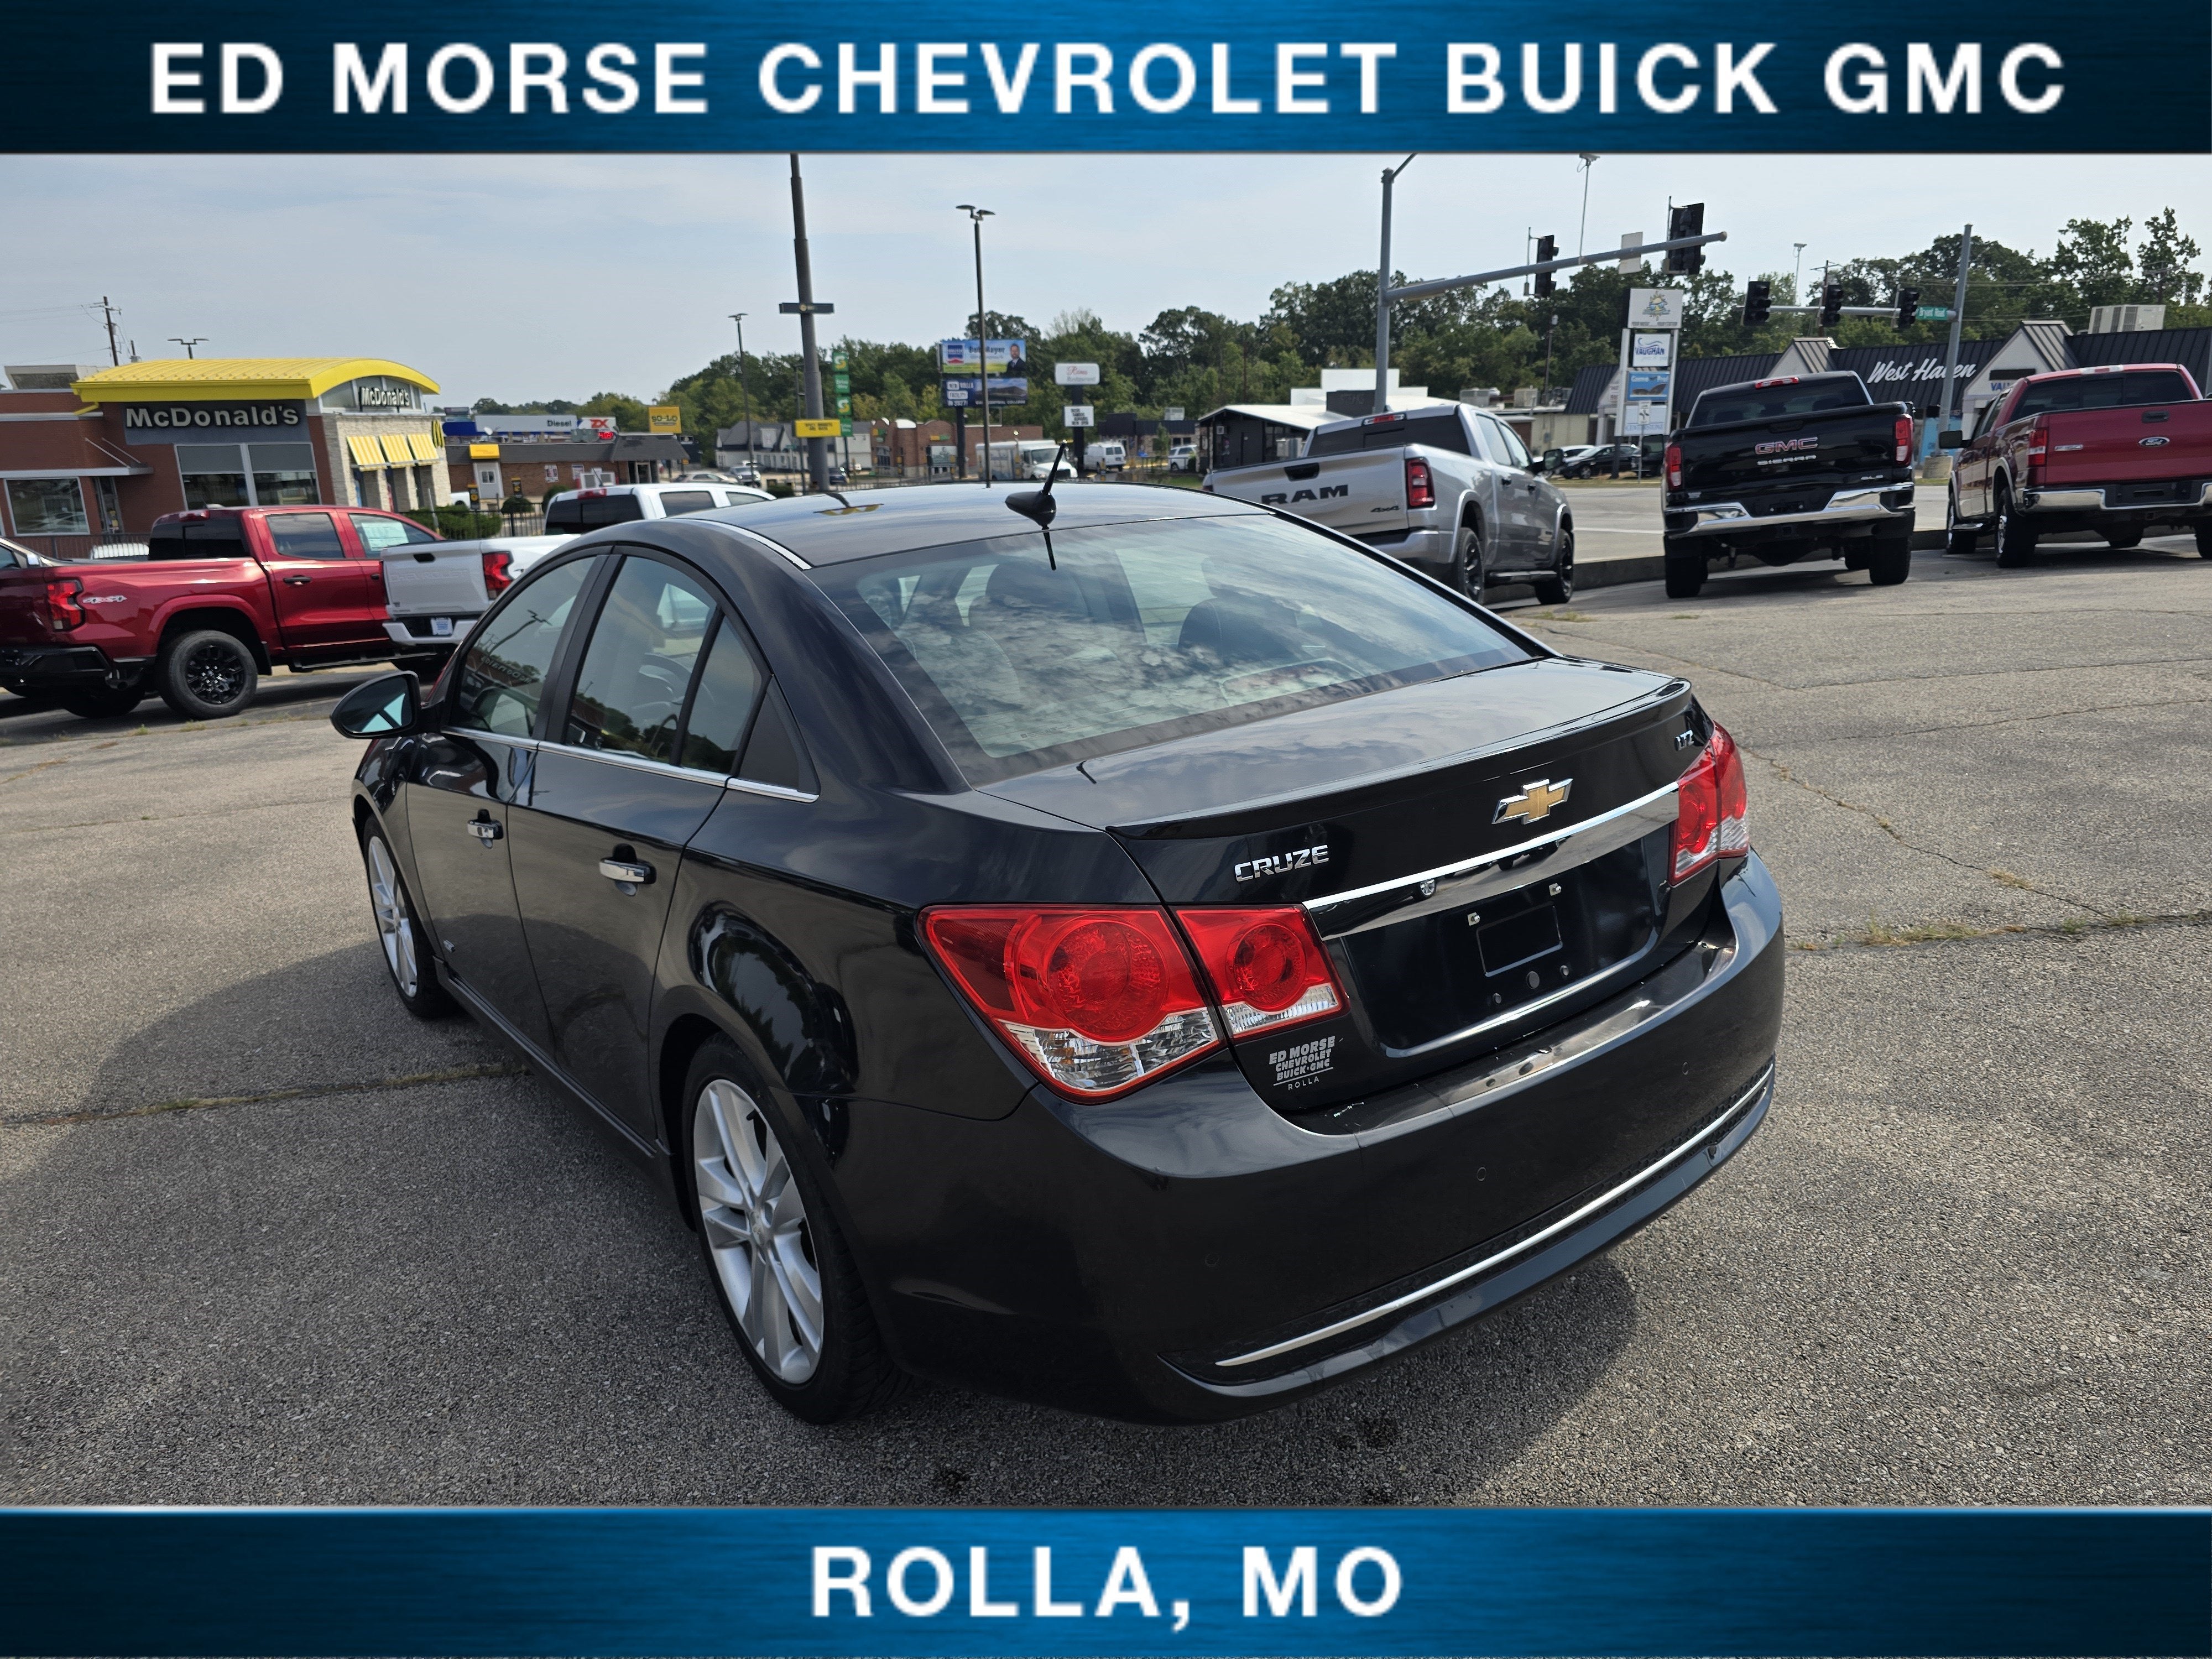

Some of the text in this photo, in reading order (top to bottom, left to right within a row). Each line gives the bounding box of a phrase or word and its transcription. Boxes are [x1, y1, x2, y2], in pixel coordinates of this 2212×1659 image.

[1867, 361, 1913, 384] West
[358, 387, 410, 407] McDonald's
[126, 406, 299, 428] McDonald's
[1755, 437, 1818, 455] GMC
[1261, 484, 1348, 504] RAM
[1674, 730, 1694, 751] LTZ
[1234, 844, 1329, 882] CRUZE
[1269, 1035, 1335, 1065] ED MORSE
[1275, 1048, 1332, 1072] CHEVROLET
[1288, 1076, 1319, 1090] ROLLA
